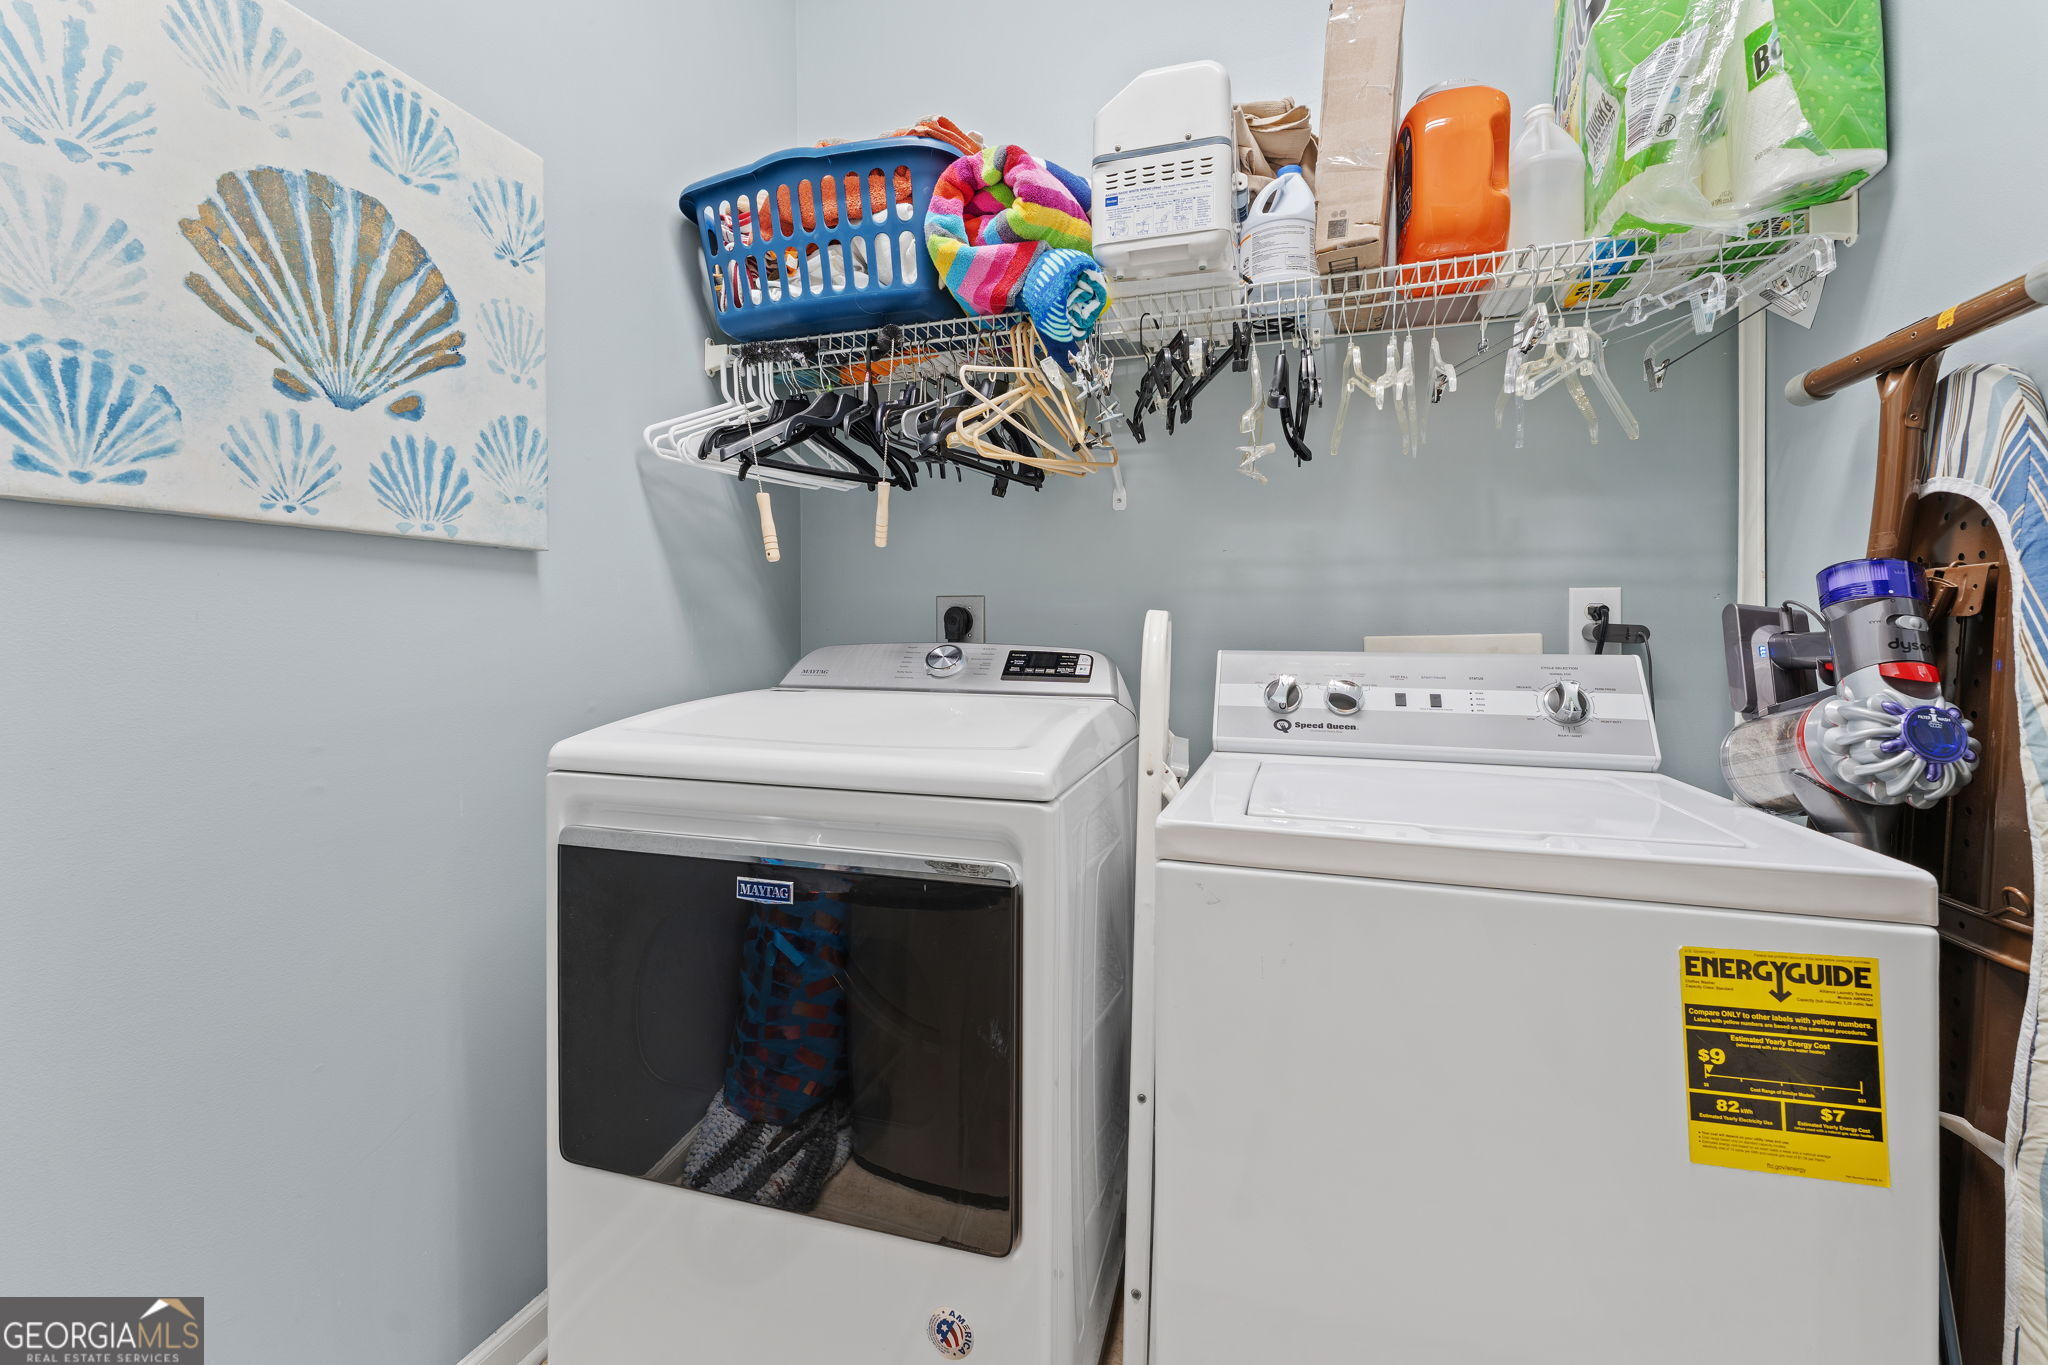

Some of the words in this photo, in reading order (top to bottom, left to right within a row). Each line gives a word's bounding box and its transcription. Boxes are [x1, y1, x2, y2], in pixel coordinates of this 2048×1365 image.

[1294, 721, 1324, 730] Speed
[1326, 722, 1357, 731] Queen
[740, 883, 788, 899] MAYTAG
[1685, 956, 1872, 989] ENERGYGUIDE
[1688, 1007, 1720, 1017] Compare
[1721, 1010, 1741, 1018] ONLY
[1751, 1013, 1771, 1021] other
[1772, 1014, 1793, 1022] labels
[1795, 1016, 1811, 1024] with
[1812, 1018, 1837, 1026] yellow
[1837, 1020, 1873, 1030] numbers.
[1730, 1034, 1764, 1044] Estimated
[1765, 1038, 1787, 1047] Yearly
[1787, 1040, 1812, 1049] Energy
[1813, 1042, 1831, 1050] Cost
[1697, 1047, 1726, 1065] $9
[1716, 1099, 1740, 1113] 82
[1698, 1112, 1722, 1120] Estimated
[1738, 1117, 1762, 1125] Electricity
[1820, 1108, 1845, 1123] $7
[1797, 1120, 1822, 1129] Estimated
[1823, 1123, 1839, 1131] Yearly
[1839, 1125, 1857, 1133] Energy
[1766, 1162, 1806, 1174] ftc.gov/energy
[948, 1310, 972, 1355] AMERICA
